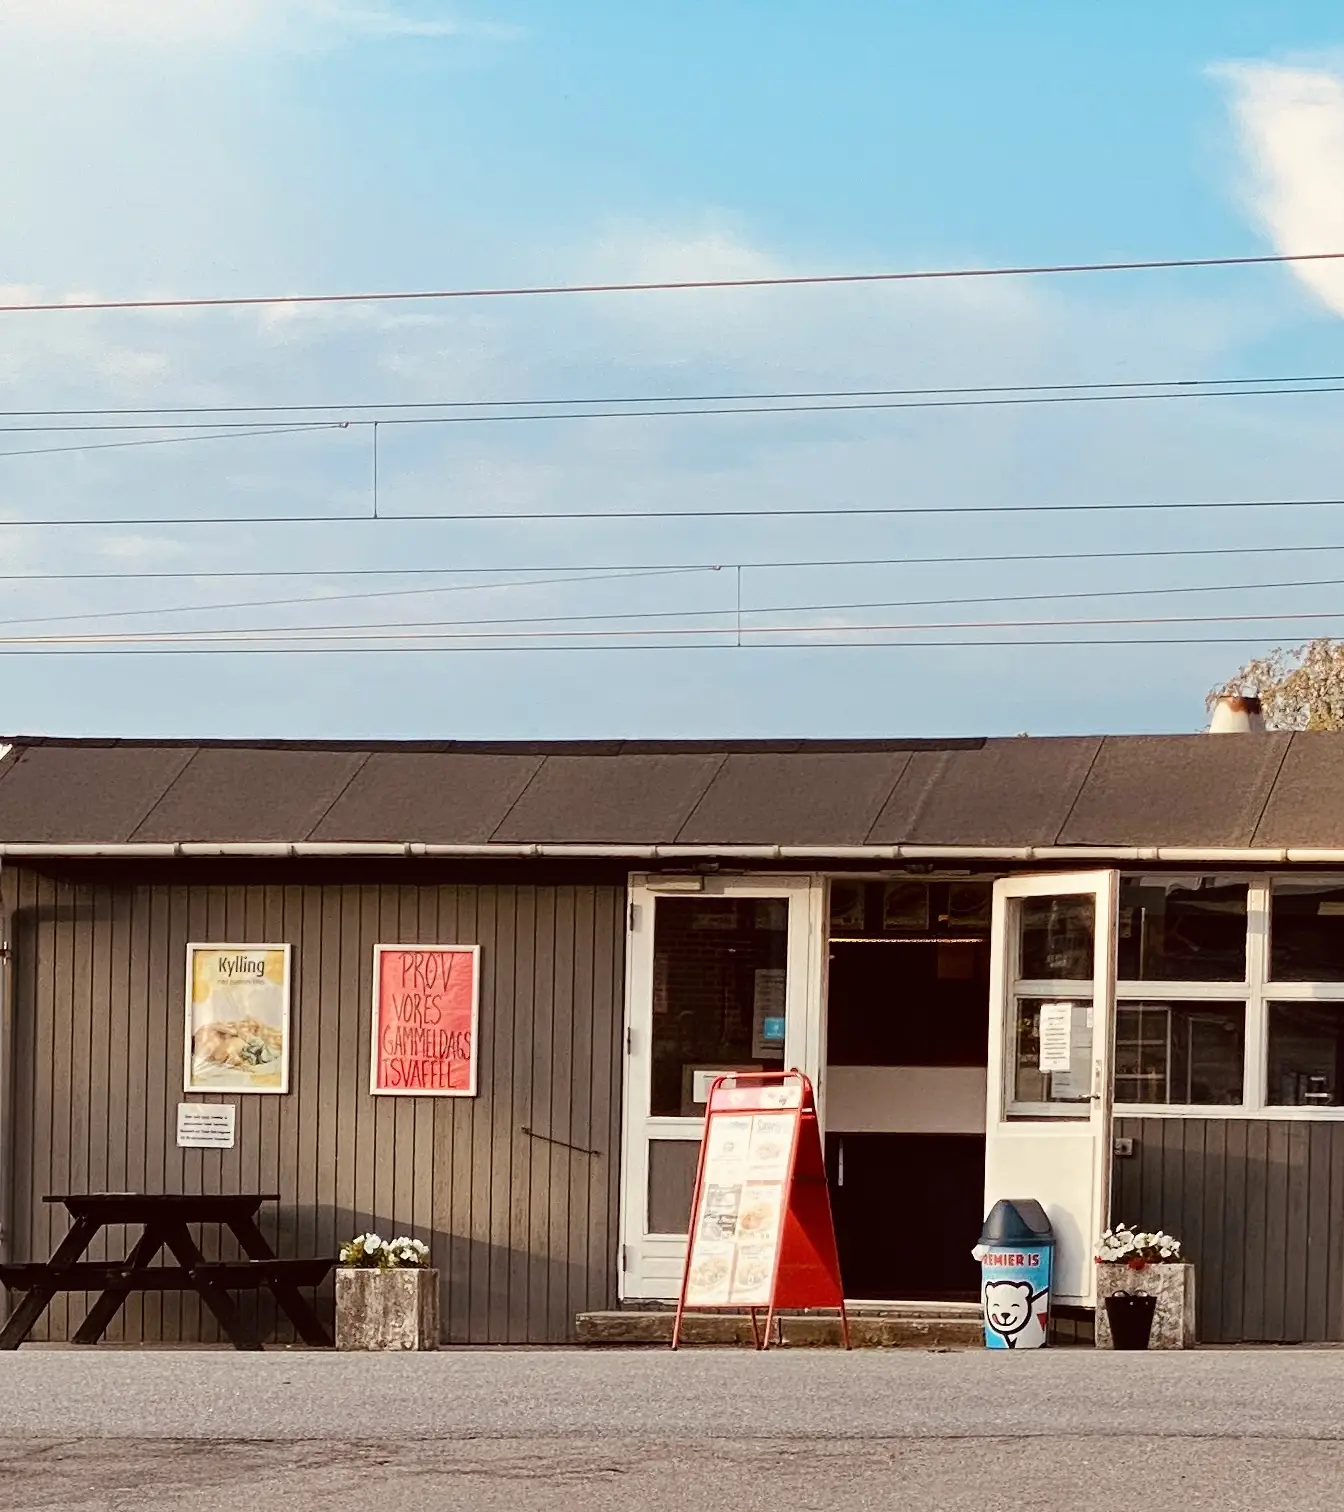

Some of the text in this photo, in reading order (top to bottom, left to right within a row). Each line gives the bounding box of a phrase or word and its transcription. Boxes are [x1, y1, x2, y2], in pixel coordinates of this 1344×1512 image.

[218, 956, 265, 977] Kylling
[392, 993, 442, 1028] VORES
[382, 1024, 472, 1061] GAMMELDAGS
[383, 1058, 457, 1089] ISVAFFEL
[1028, 1254, 1039, 1266] IS
